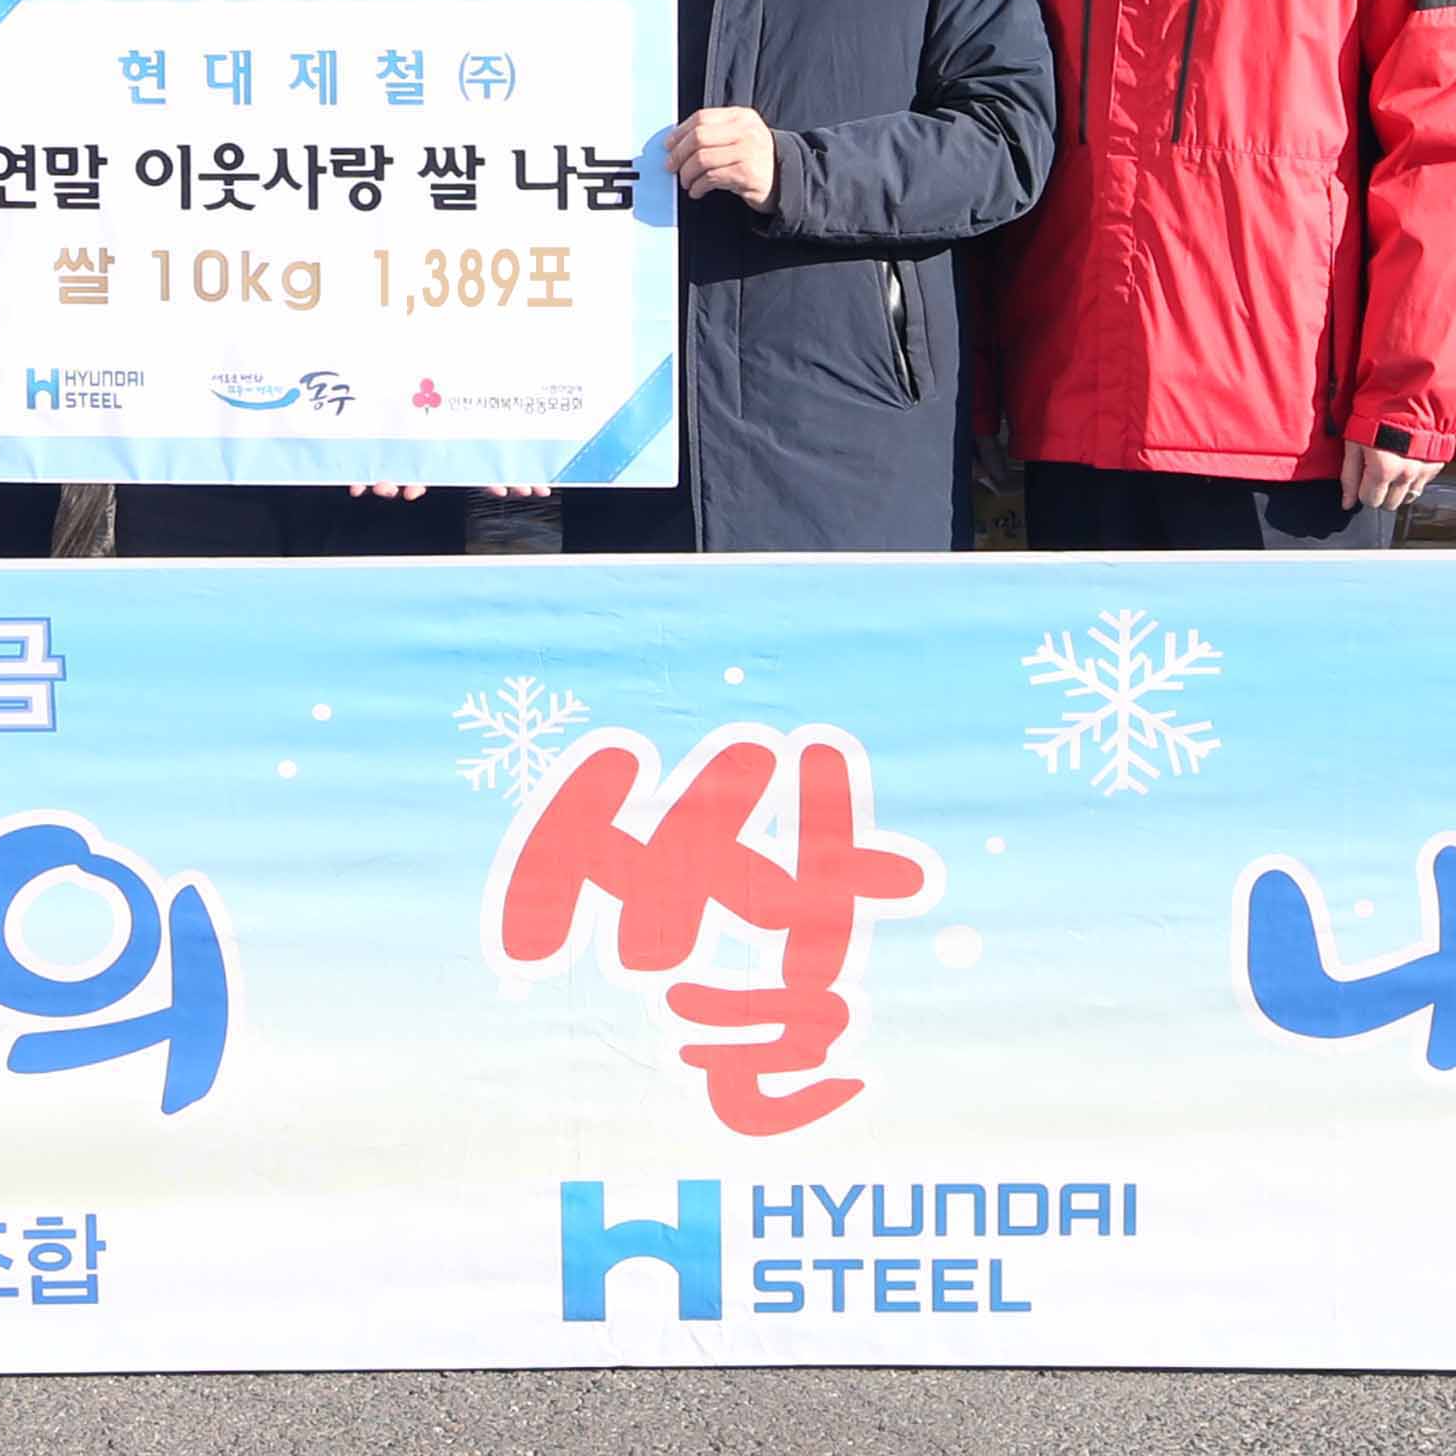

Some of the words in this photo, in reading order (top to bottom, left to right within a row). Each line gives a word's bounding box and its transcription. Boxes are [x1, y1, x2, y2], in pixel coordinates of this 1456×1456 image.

[135, 142, 394, 212] 이웃사랑
[418, 145, 486, 211] 쌀
[513, 145, 641, 211] 나눔
[53, 247, 116, 305] 쌀
[152, 249, 322, 312] 10kg
[374, 247, 574, 316] 1,389포
[64, 370, 145, 388] HYUNDAI
[65, 391, 123, 410] STEEL
[300, 371, 356, 416] 동구
[501, 741, 925, 1138] 쌀
[752, 1183, 1137, 1239] HYUNDAI
[753, 1258, 1032, 1314] STEEL
